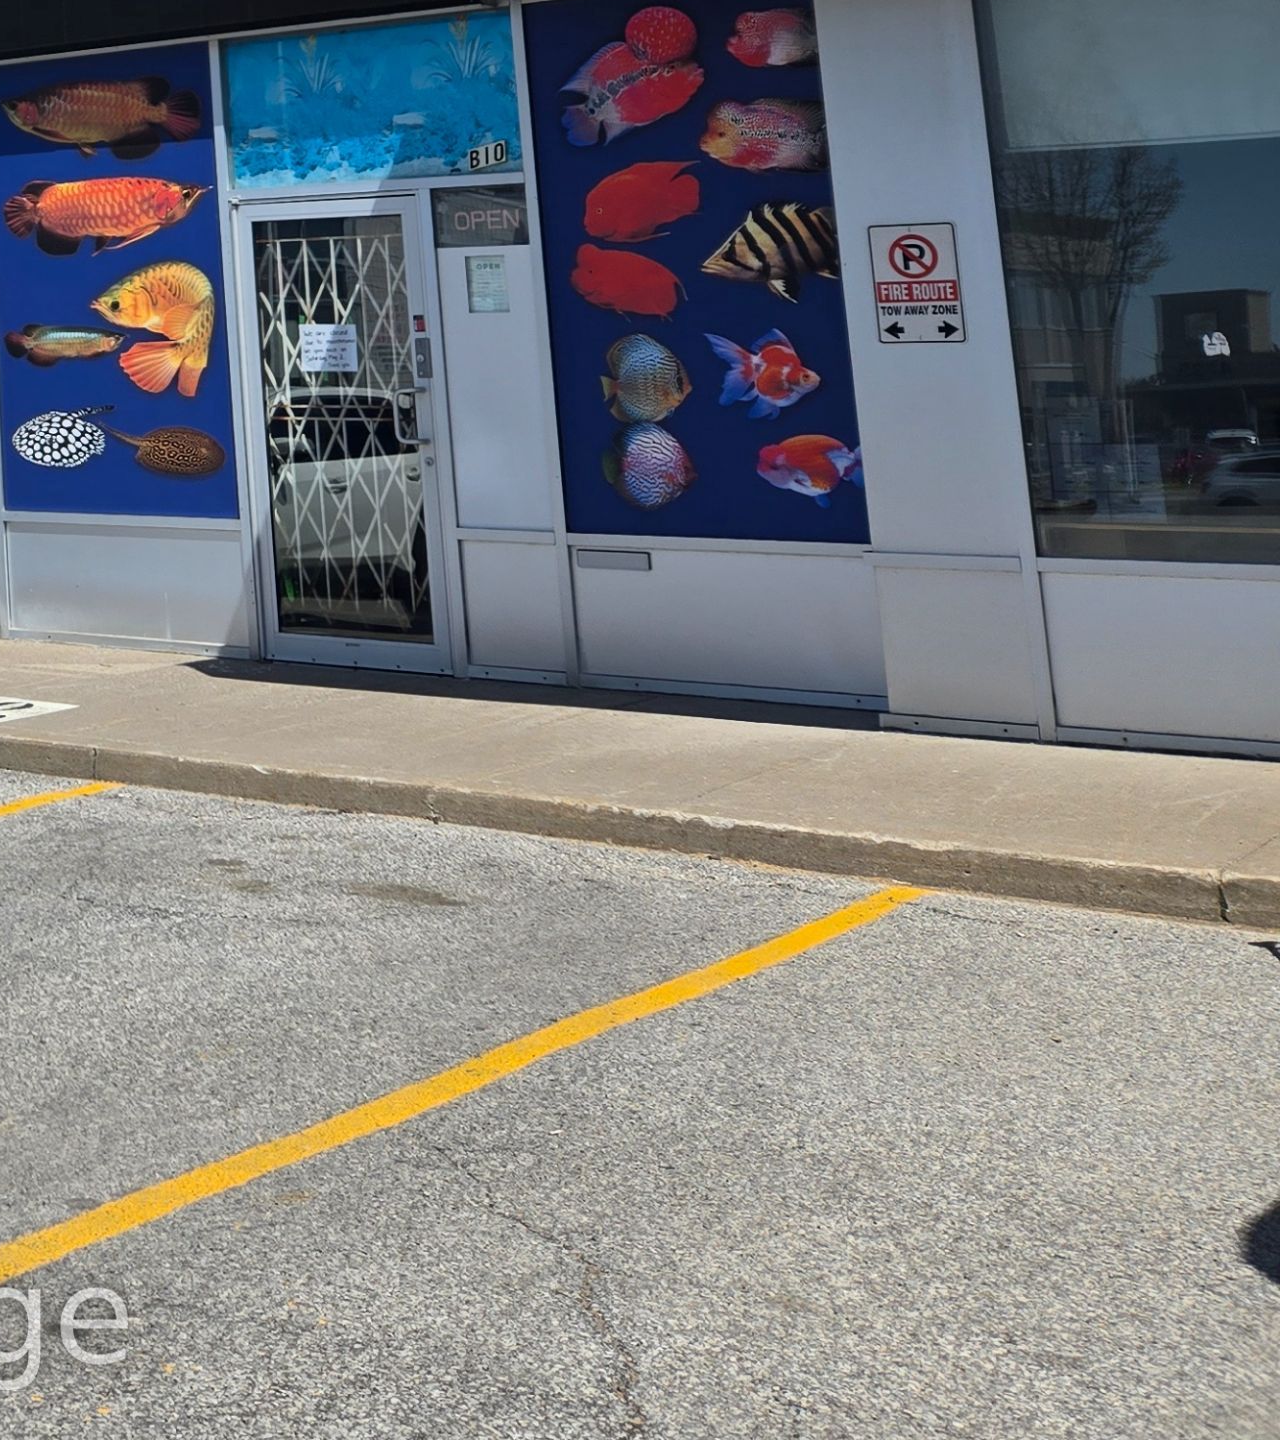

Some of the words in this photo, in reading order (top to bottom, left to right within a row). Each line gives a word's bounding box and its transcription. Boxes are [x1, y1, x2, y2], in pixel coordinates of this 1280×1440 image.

[454, 209, 520, 231] OPEN
[881, 284, 910, 301] FIRE
[912, 282, 955, 300] ROUTE
[881, 306, 901, 316] TOW
[904, 305, 930, 316] AWAY
[932, 304, 959, 315] ZONE
